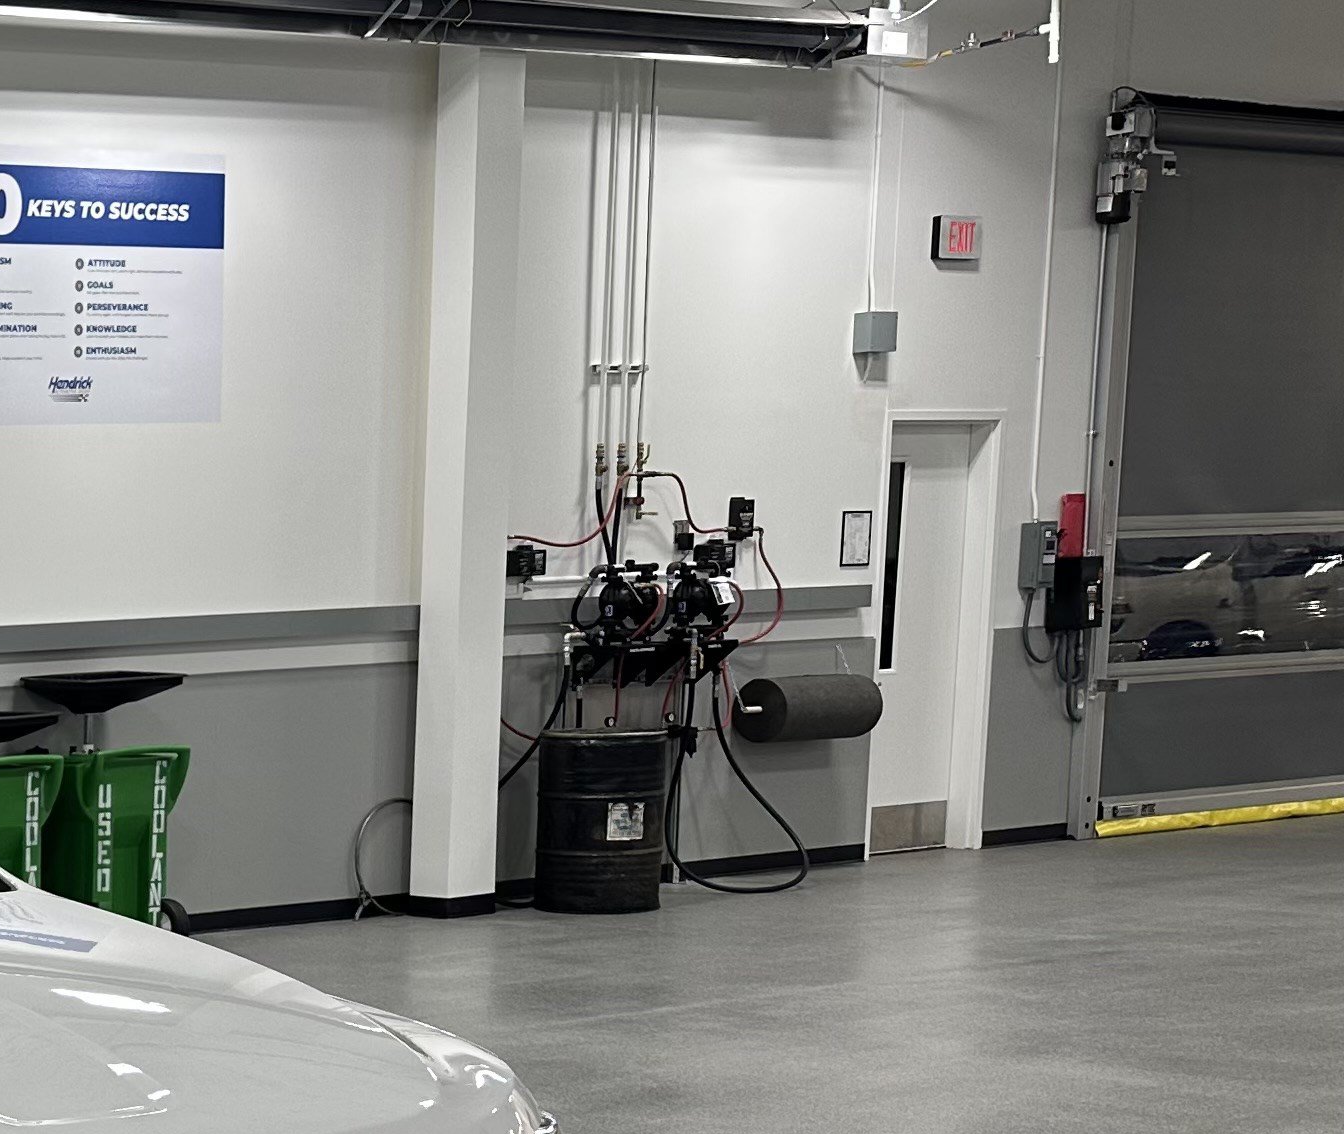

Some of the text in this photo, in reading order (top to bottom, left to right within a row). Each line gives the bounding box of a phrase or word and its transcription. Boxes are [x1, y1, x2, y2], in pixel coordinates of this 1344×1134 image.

[27, 199, 76, 218] KEYS
[80, 201, 105, 219] TO
[108, 202, 190, 222] SUCCESS
[949, 221, 976, 253] EXIT
[87, 259, 126, 268] ATTITUDE
[87, 281, 113, 289] GOALS
[87, 303, 149, 311] PERSEVERANCE
[86, 325, 137, 333] KNOWLEDGE
[86, 346, 137, 355] ENTHUSIASM
[48, 376, 93, 393] Hendrick
[97, 783, 111, 892] USED
[148, 760, 167, 927] COOLANT
